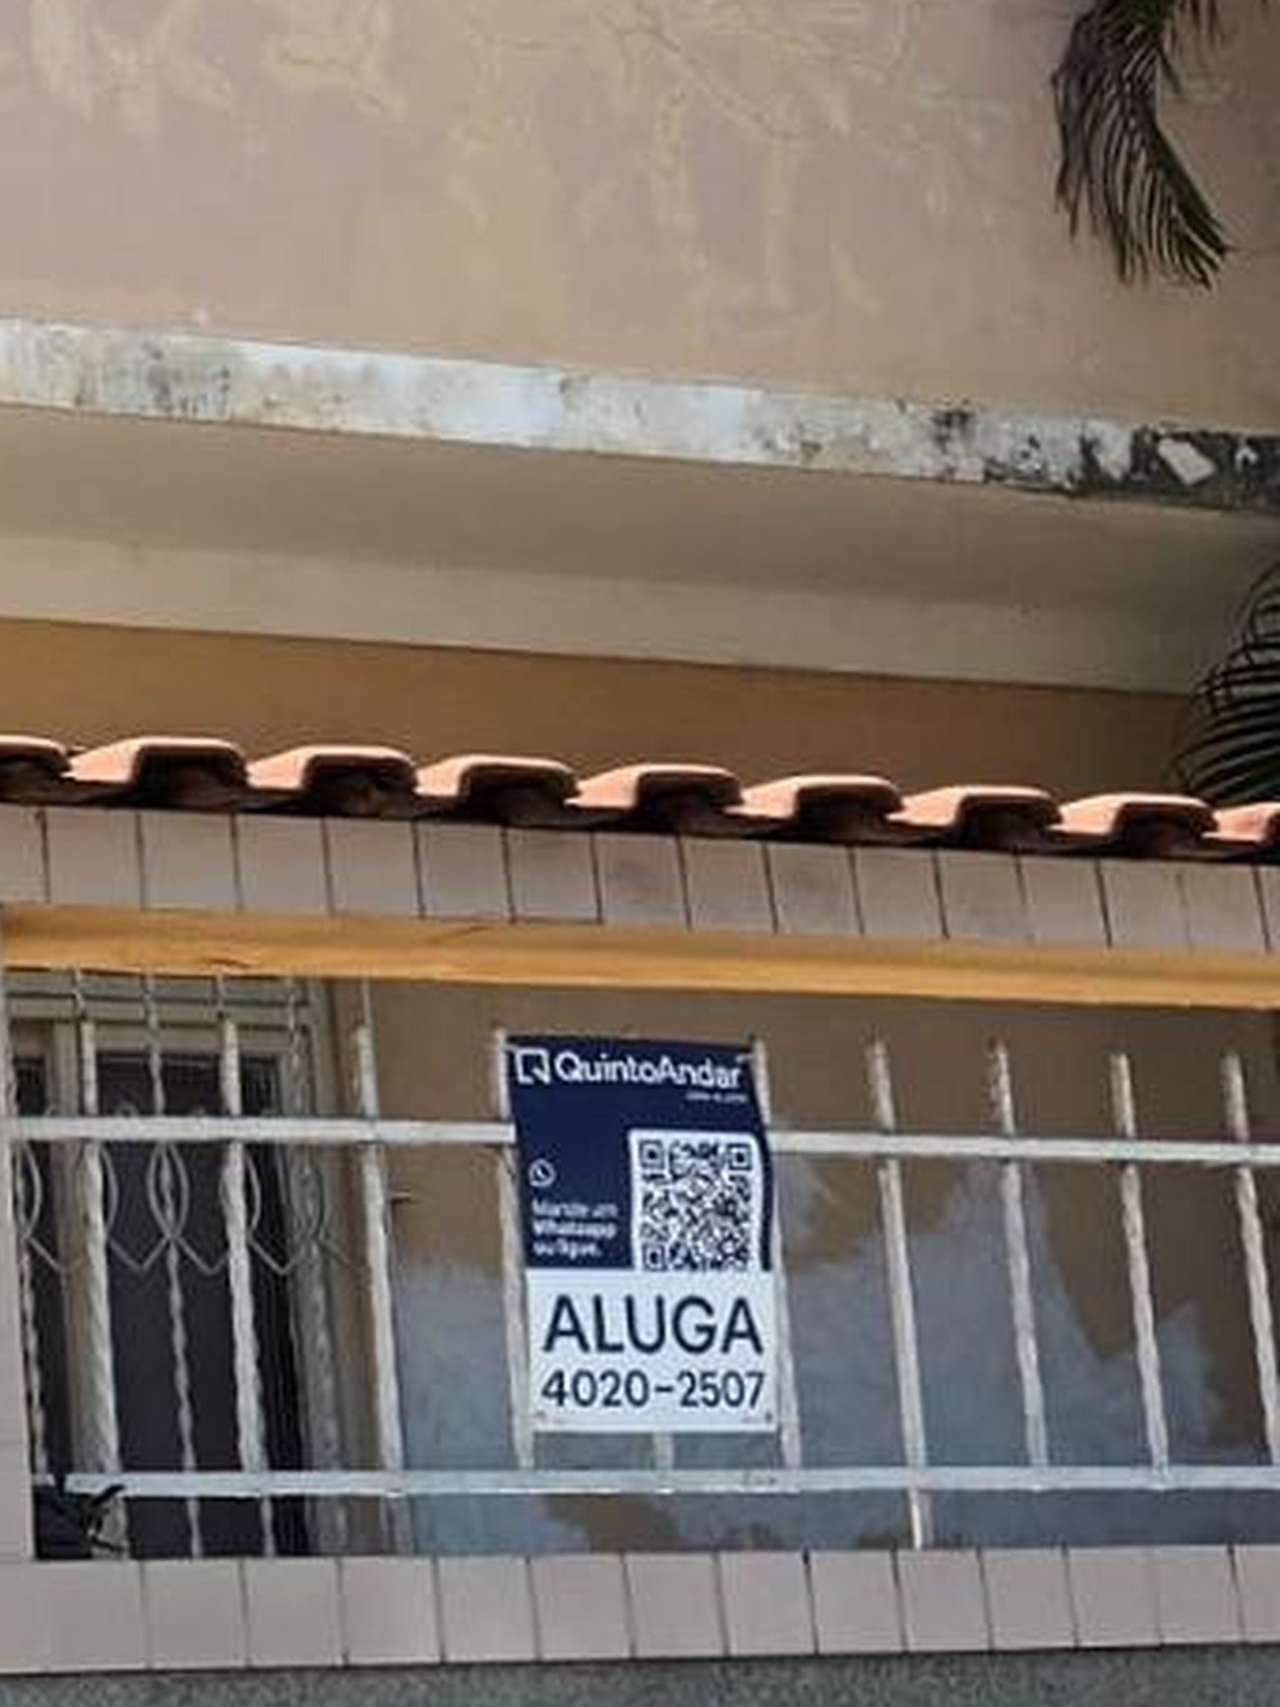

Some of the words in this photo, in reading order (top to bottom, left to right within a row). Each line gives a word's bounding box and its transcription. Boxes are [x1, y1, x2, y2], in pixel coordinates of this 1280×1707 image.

[554, 1051, 742, 1089] QuintoAndar
[541, 1295, 764, 1355] ALUGA
[541, 1369, 765, 1408] 4020-2507
